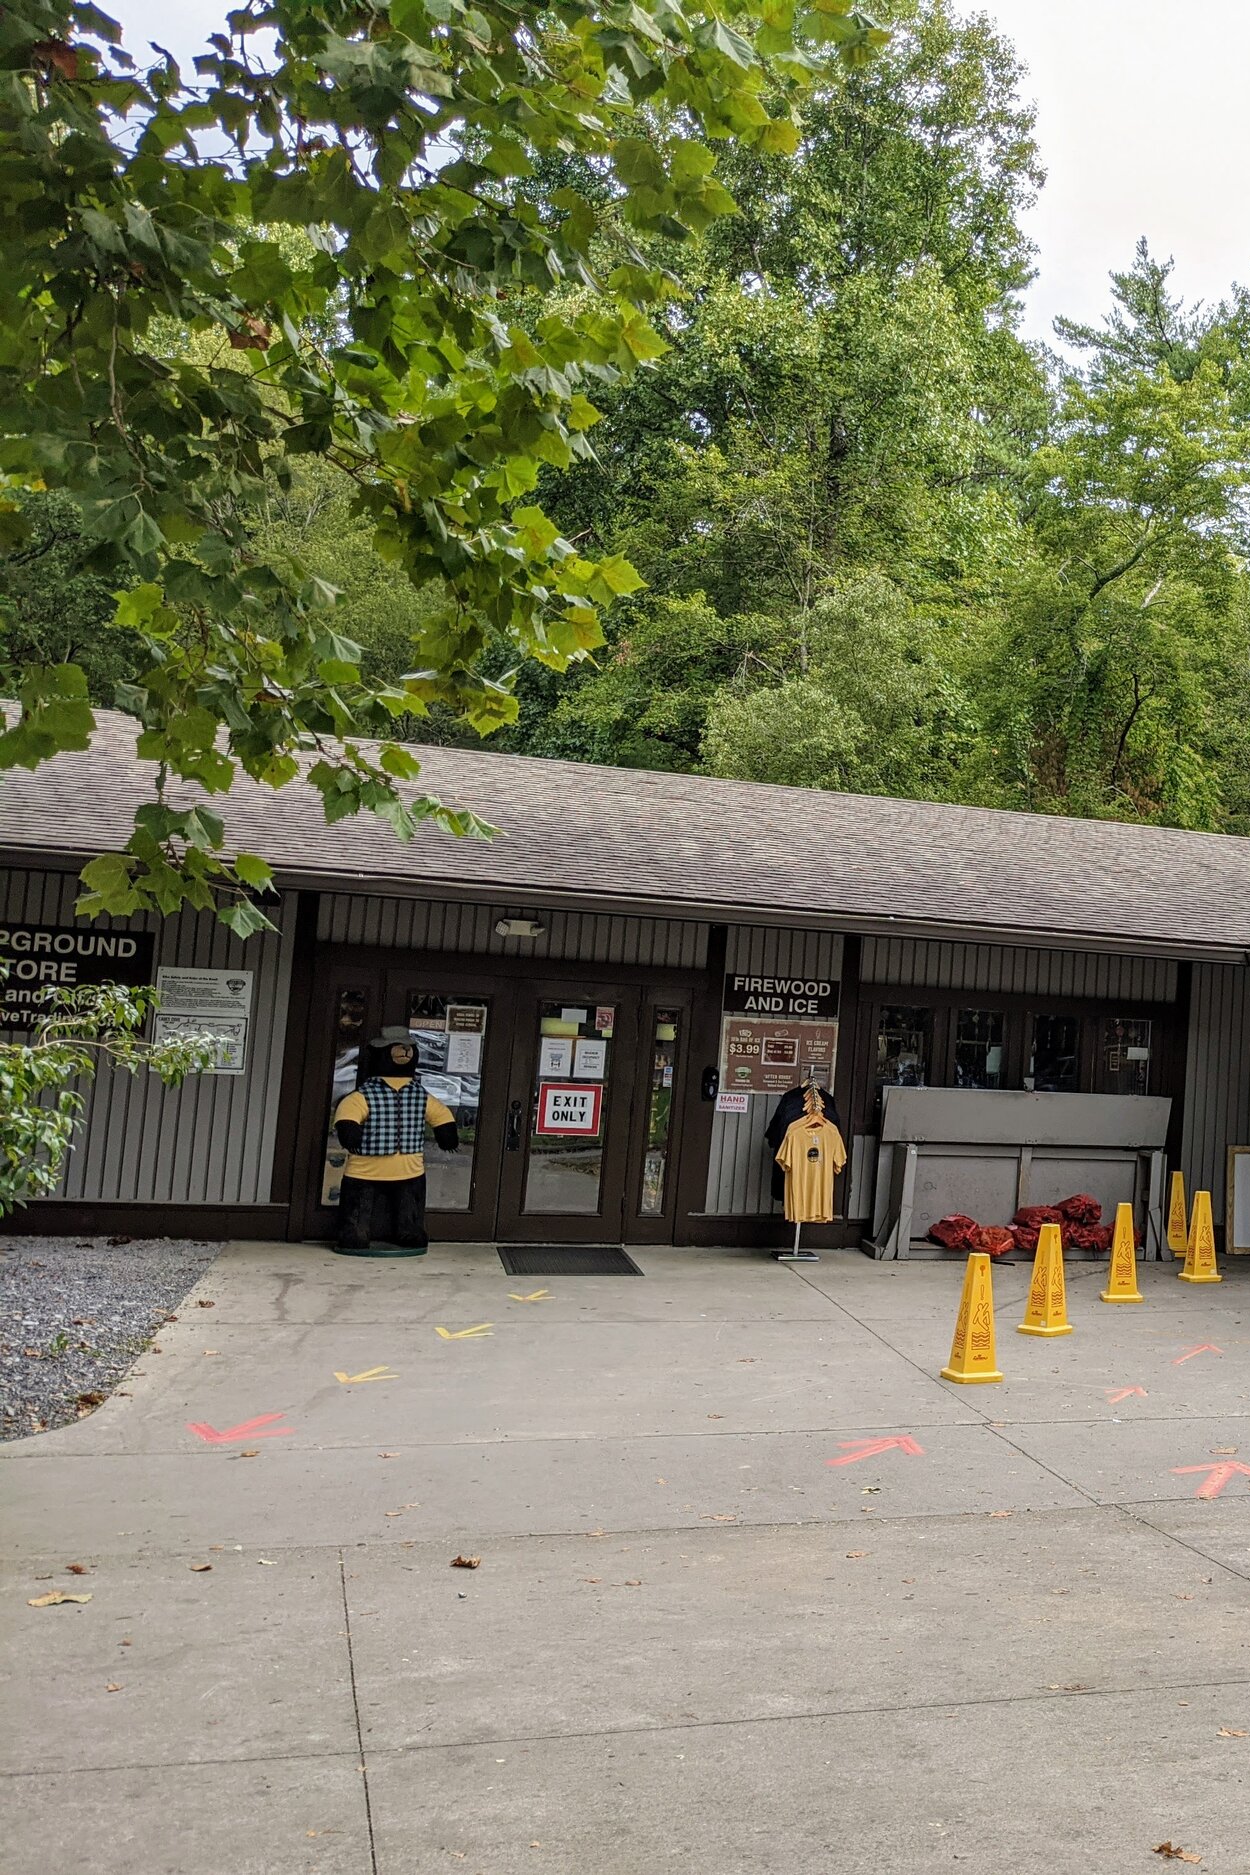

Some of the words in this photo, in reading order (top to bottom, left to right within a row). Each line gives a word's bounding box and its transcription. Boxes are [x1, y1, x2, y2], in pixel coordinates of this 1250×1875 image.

[733, 977, 831, 997] FIREWOOD
[744, 996, 784, 1012] AND
[788, 999, 819, 1014] ICE
[729, 1043, 760, 1055] $3.99
[553, 1096, 588, 1108] EXIT
[720, 1095, 745, 1103] HAND
[552, 1111, 586, 1122] ONLY
